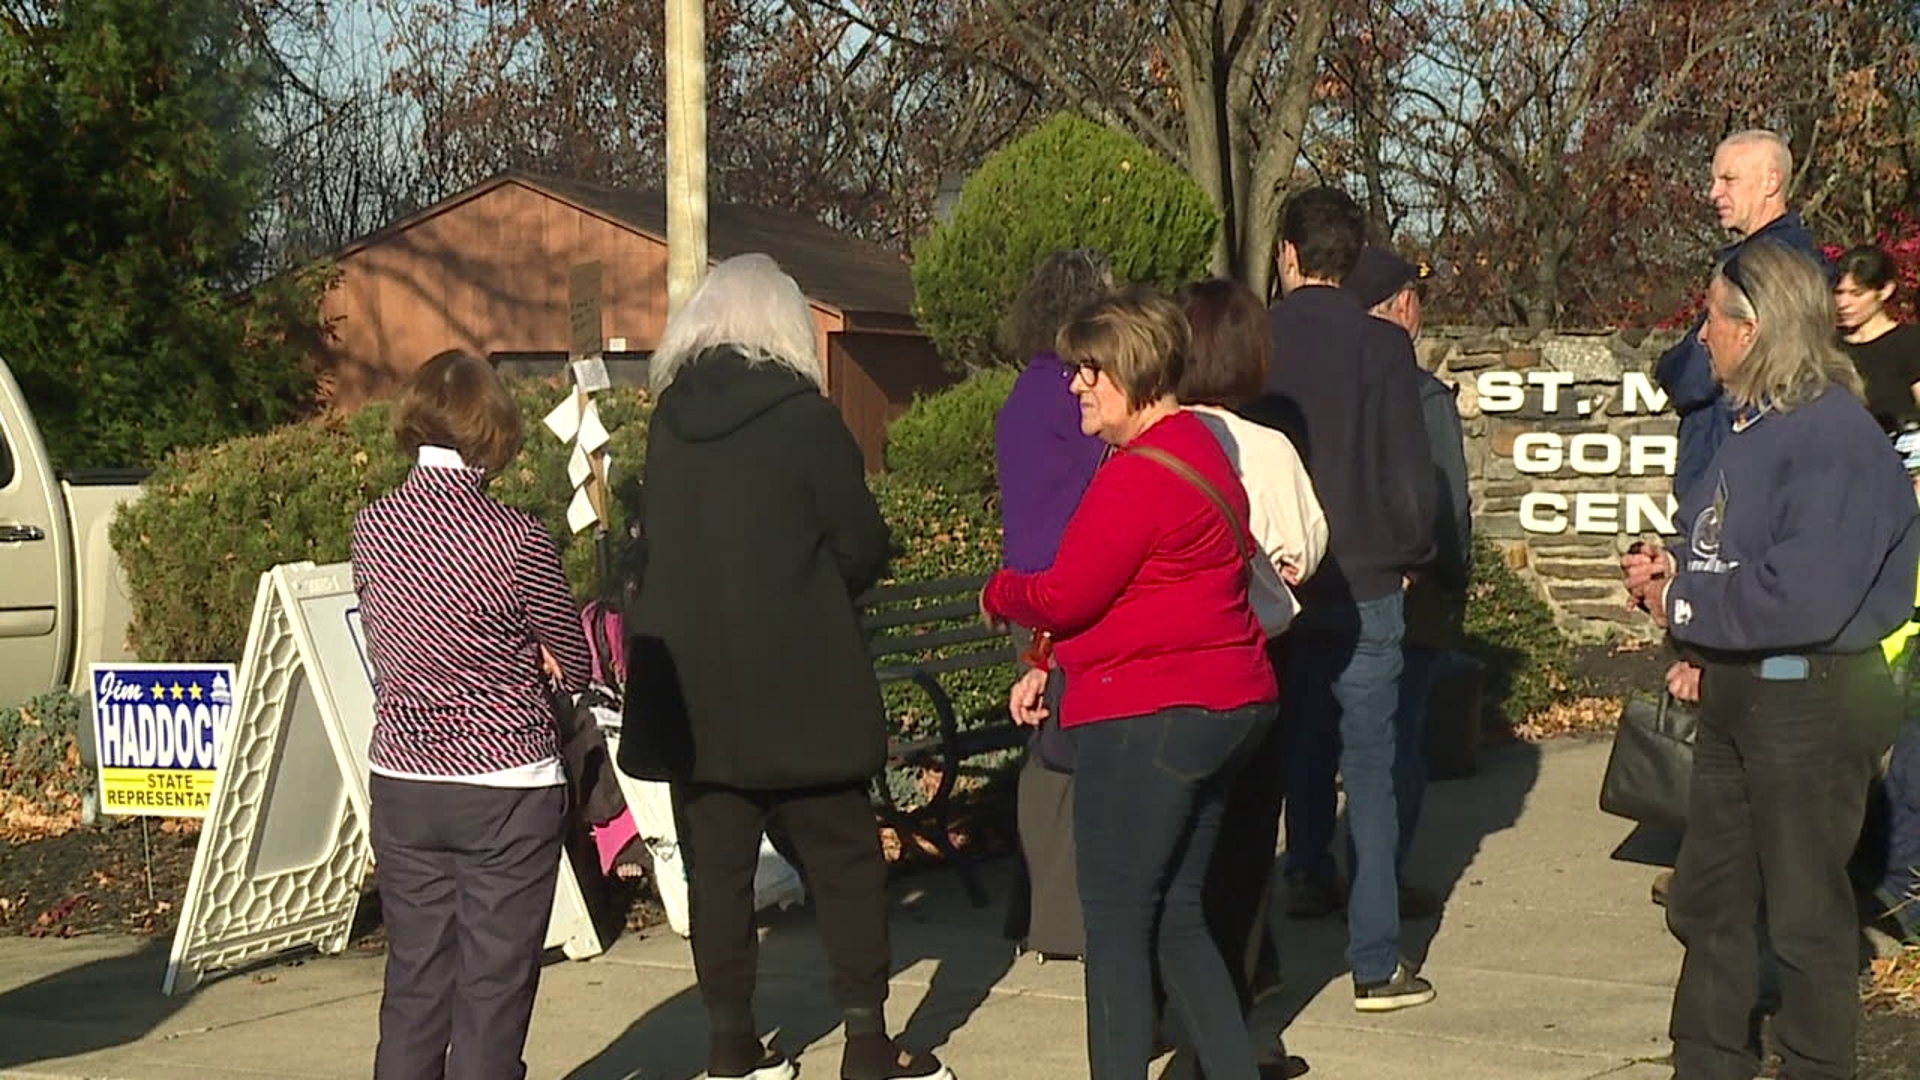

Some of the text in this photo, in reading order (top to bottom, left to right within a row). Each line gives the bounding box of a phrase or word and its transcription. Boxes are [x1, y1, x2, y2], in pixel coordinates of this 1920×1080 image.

[1513, 432, 1678, 475] GOR
[1519, 492, 1679, 534] CEN
[99, 671, 143, 708] Jim
[147, 774, 194, 789] STATE
